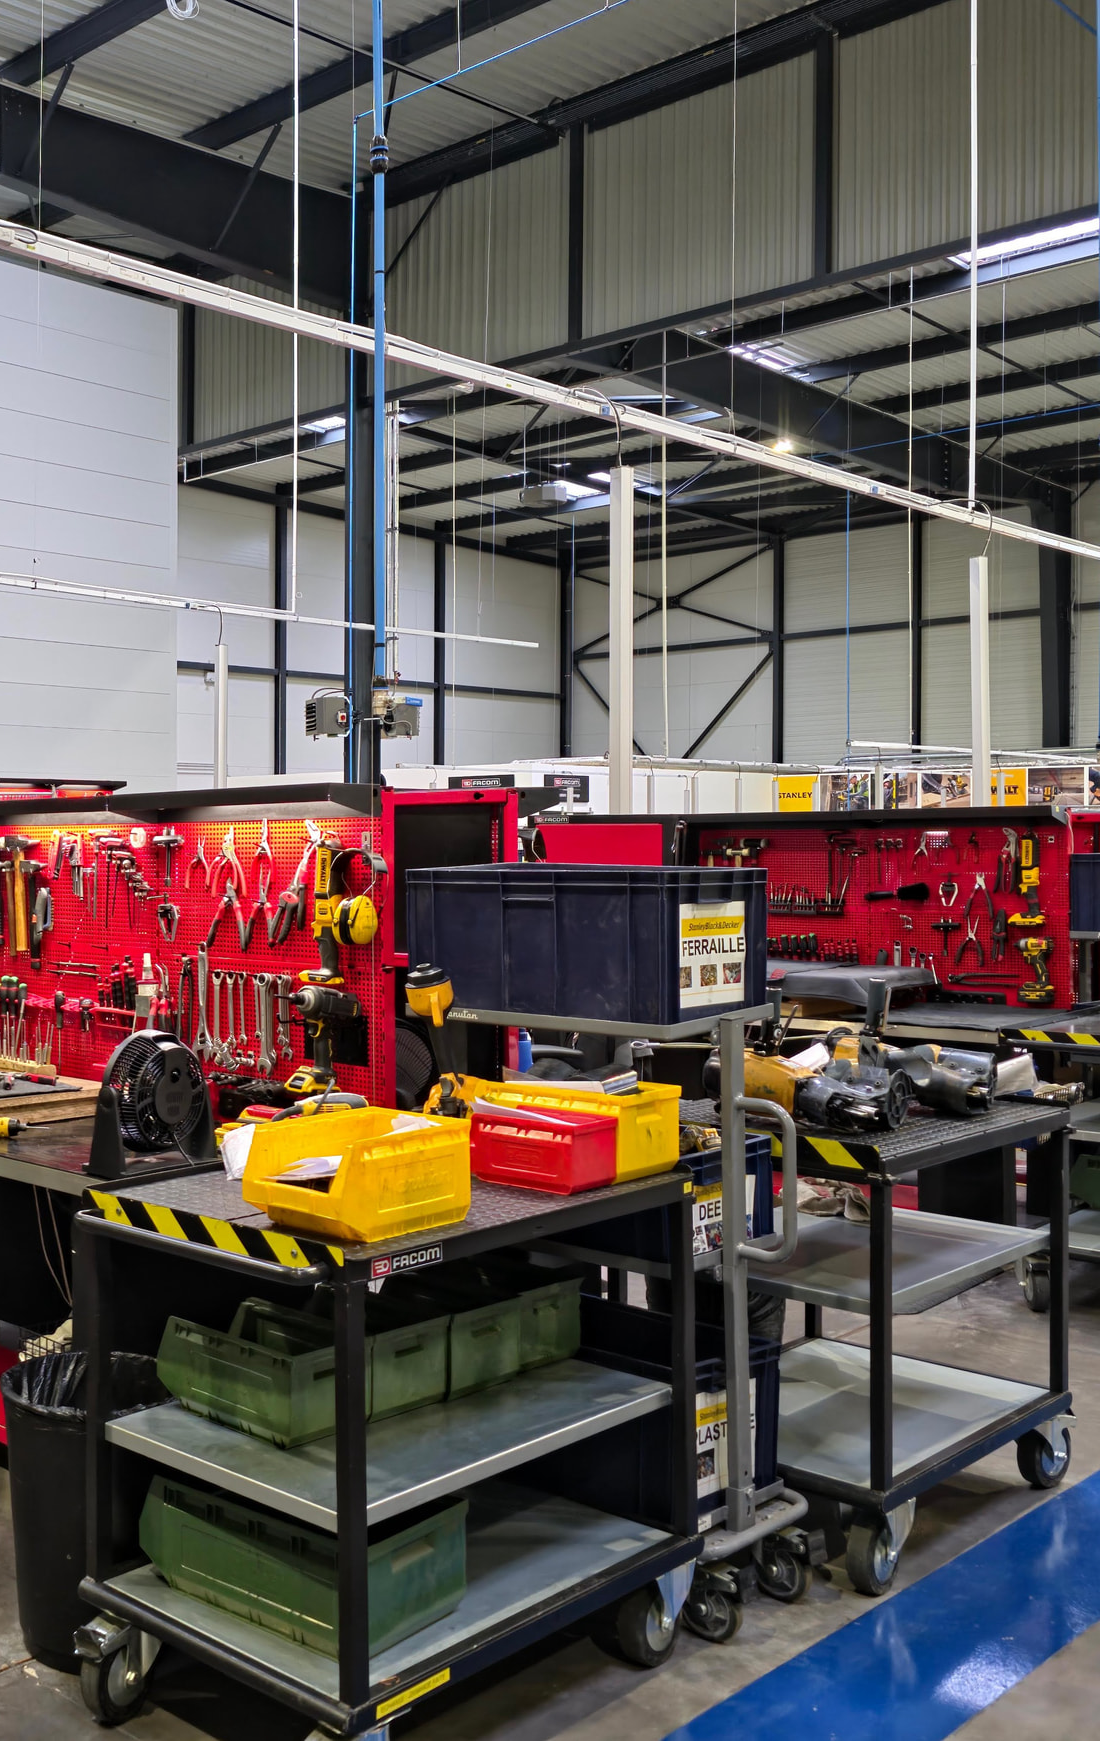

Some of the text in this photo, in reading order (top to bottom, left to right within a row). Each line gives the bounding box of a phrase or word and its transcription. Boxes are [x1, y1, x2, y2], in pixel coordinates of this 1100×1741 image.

[682, 937, 744, 957] FERRAILLE
[447, 1010, 478, 1020] anutan
[393, 1247, 440, 1269] FACOM
